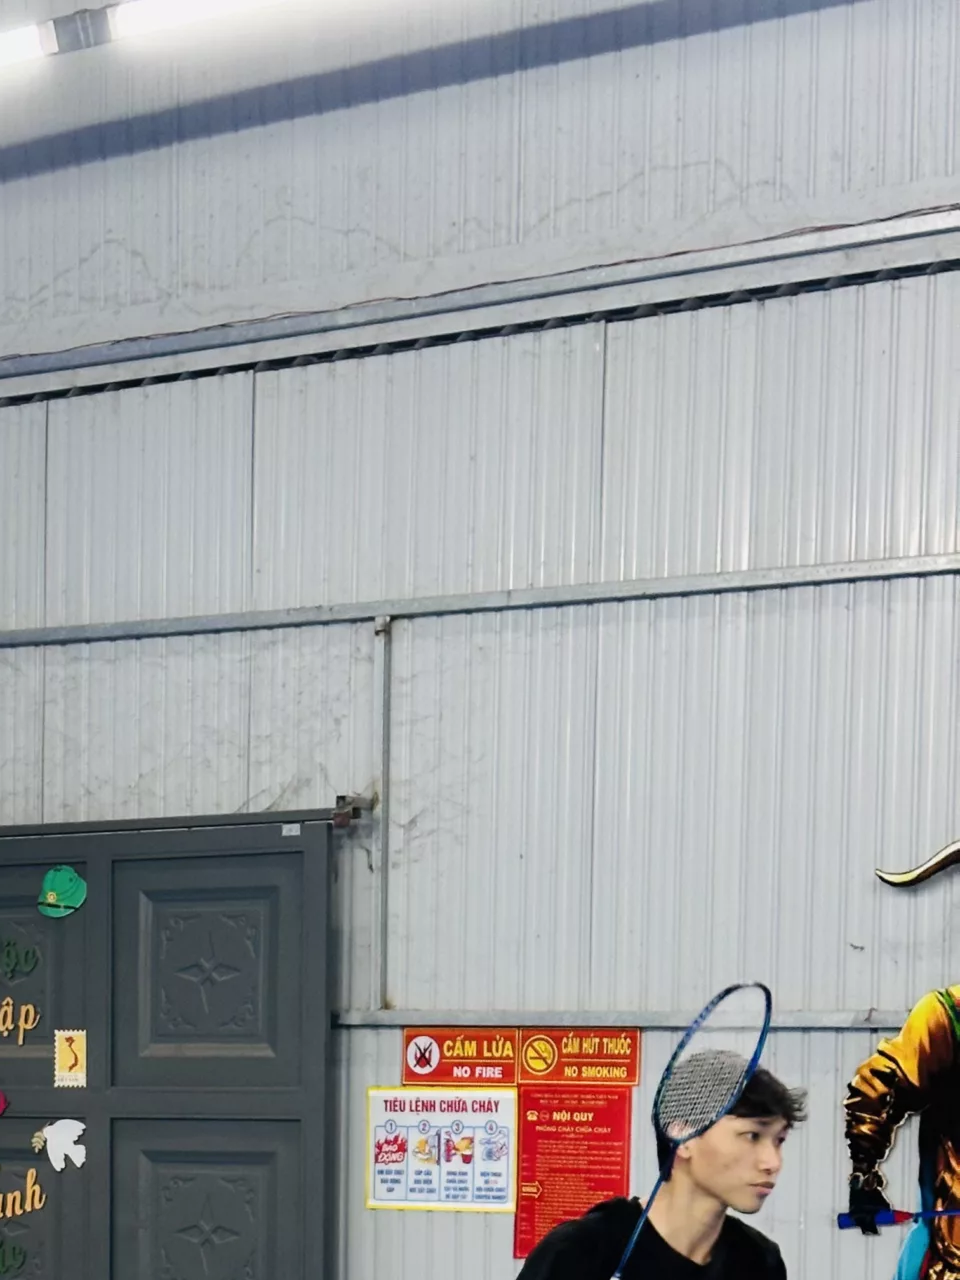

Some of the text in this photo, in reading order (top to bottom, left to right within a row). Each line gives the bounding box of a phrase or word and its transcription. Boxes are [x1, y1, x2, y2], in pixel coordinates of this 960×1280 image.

[443, 1034, 515, 1058] CẤM LỬA
[561, 1032, 632, 1055] CẤM HÚT THUỐC
[453, 1066, 503, 1078] NO FIRE
[564, 1066, 628, 1078] NO SMOKING
[383, 1097, 406, 1113] TIÊU
[409, 1097, 436, 1115] LỆNH
[471, 1097, 500, 1113] CHÁY
[552, 1110, 594, 1122] NỘI QUY
